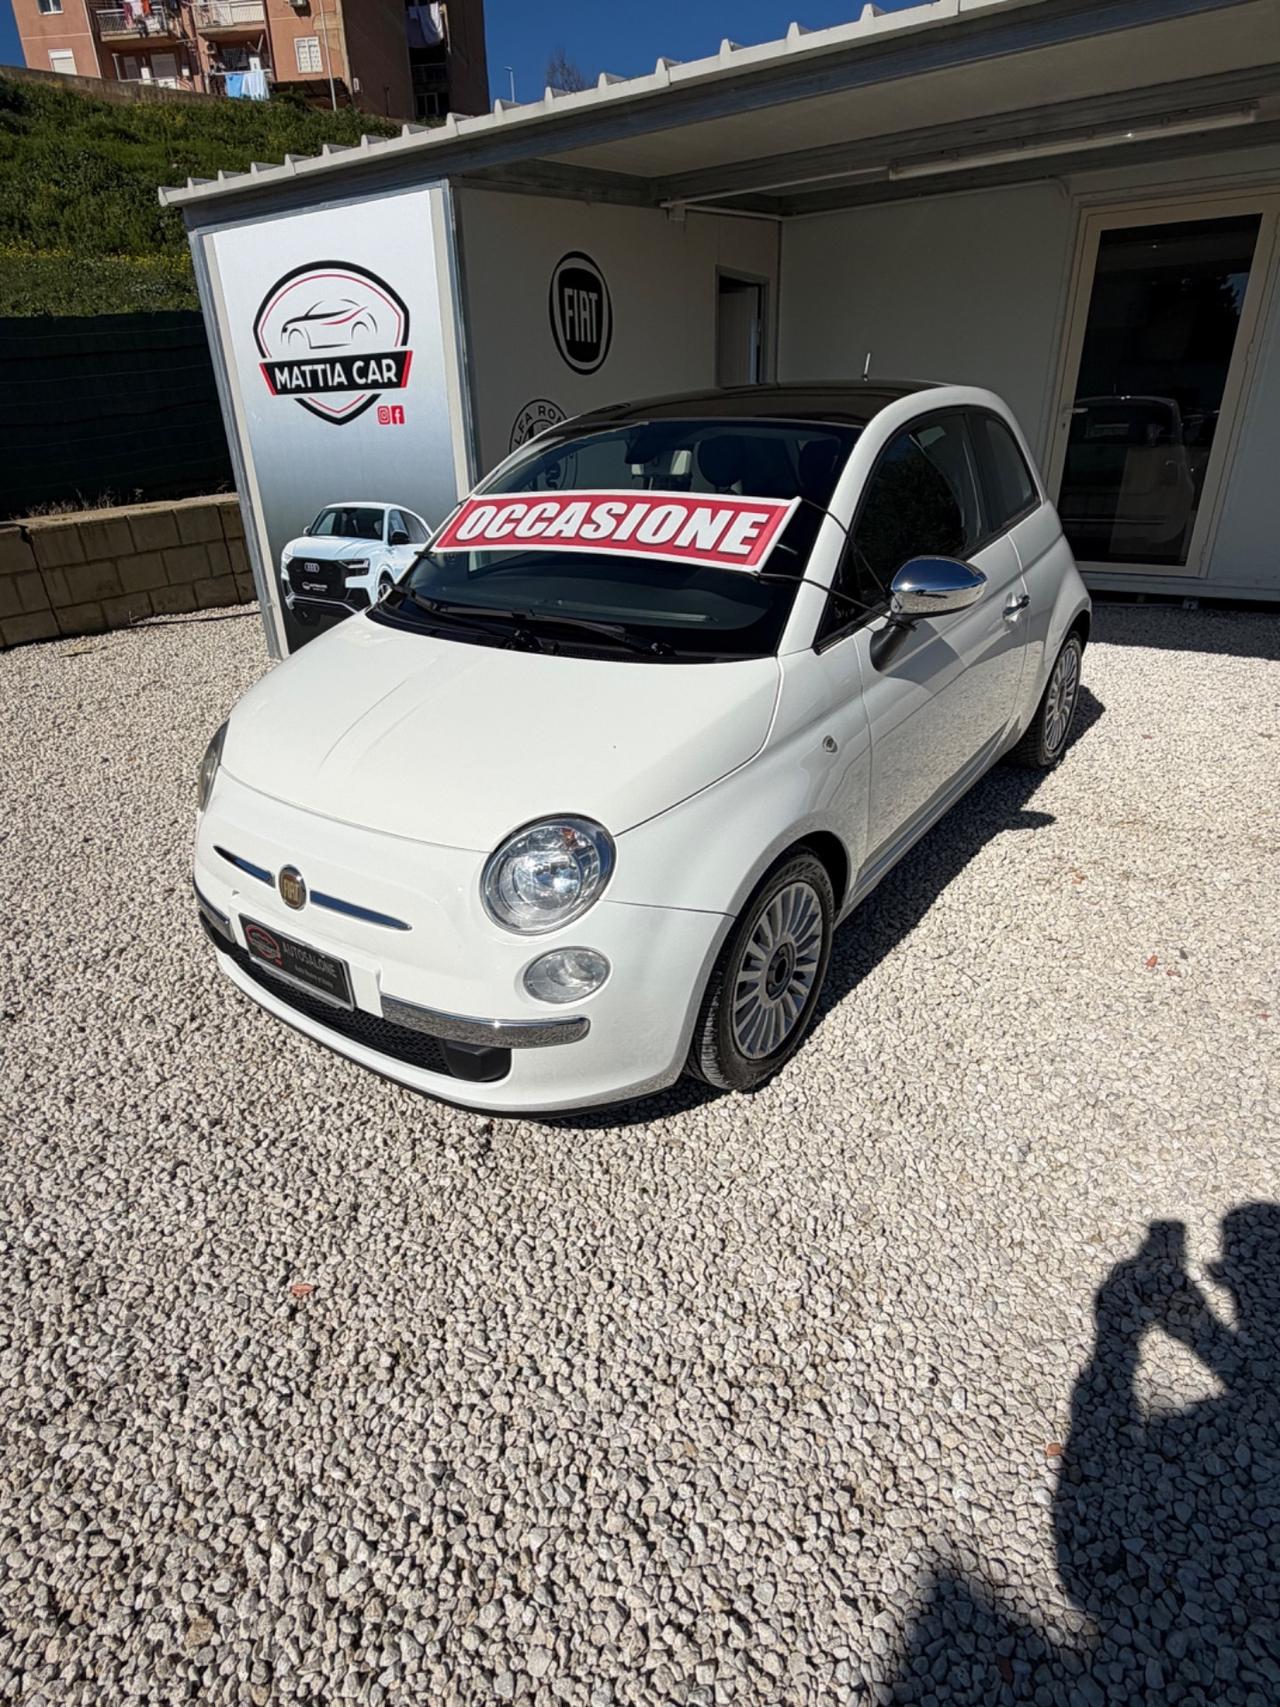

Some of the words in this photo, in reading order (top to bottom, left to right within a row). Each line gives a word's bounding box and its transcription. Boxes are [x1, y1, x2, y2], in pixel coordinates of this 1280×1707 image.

[563, 287, 598, 343] FIAT
[274, 362, 348, 390] MATTIA
[352, 358, 398, 384] CAR
[514, 412, 533, 445] LFA
[455, 502, 769, 555] OCCASIONE
[283, 878, 300, 902] FIAT
